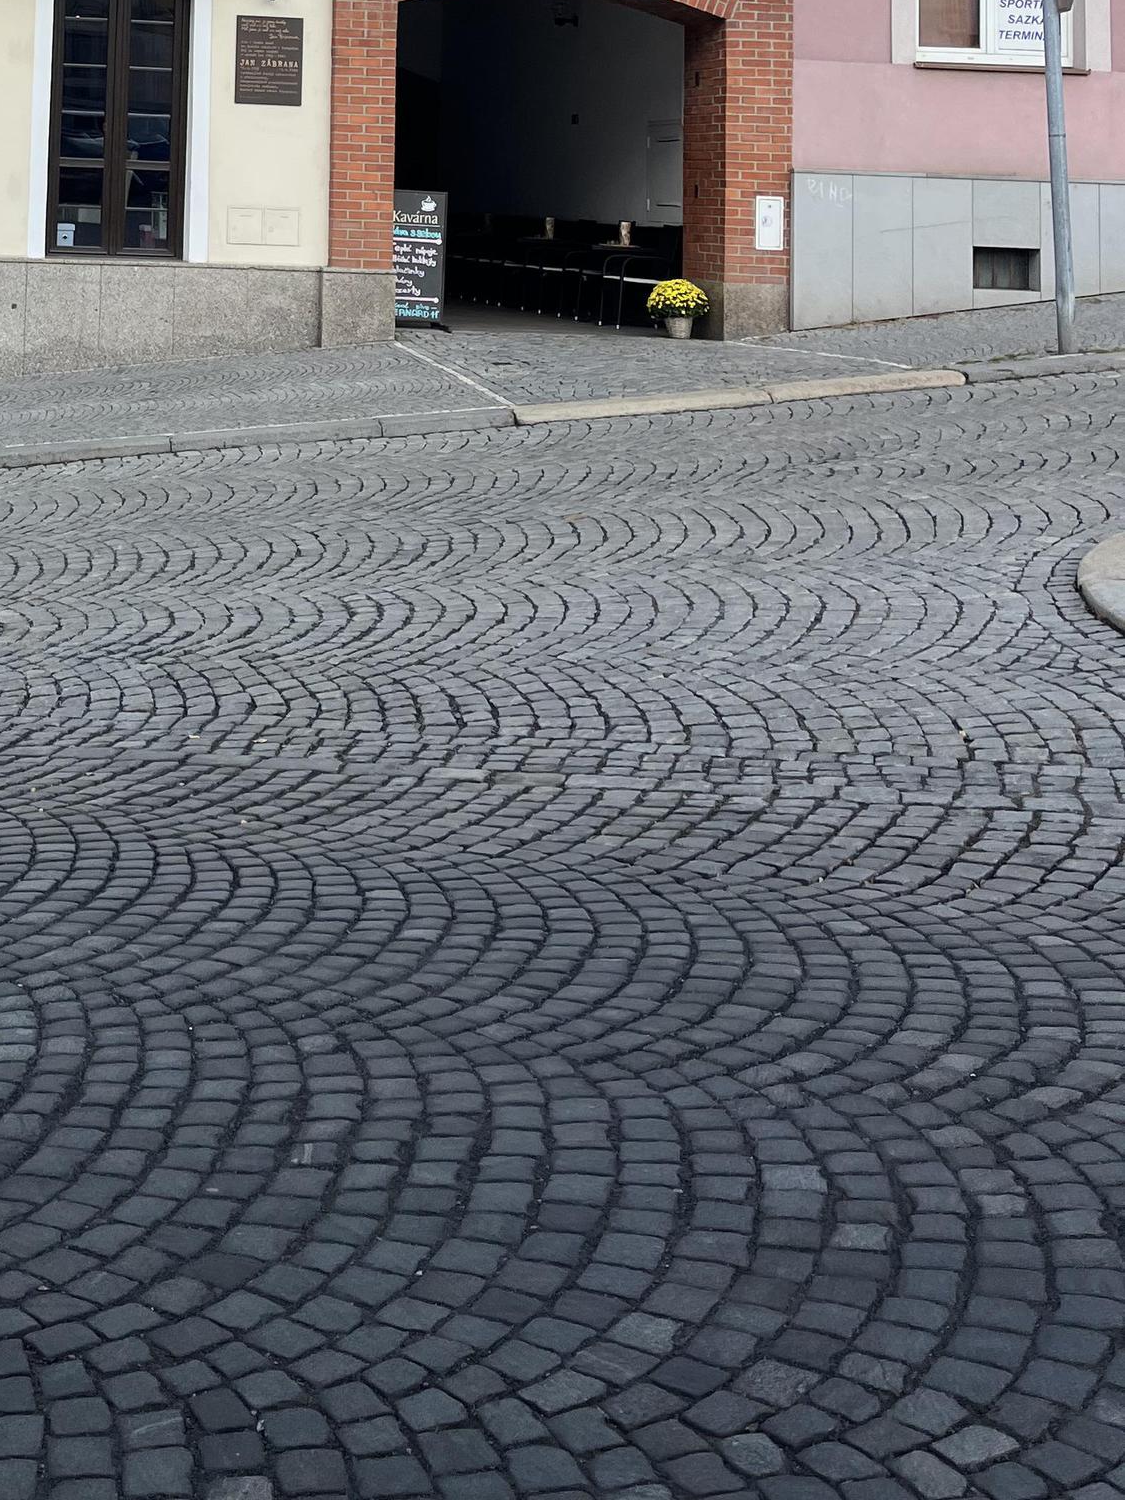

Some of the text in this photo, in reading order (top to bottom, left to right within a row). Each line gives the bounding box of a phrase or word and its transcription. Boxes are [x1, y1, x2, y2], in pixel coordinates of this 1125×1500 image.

[1007, 14, 1044, 25] SAZK
[998, 30, 1045, 41] TERMIN
[239, 58, 299, 68] JAN ZÁBRANA
[393, 210, 438, 225] Kavárna
[392, 242, 412, 255] eplé
